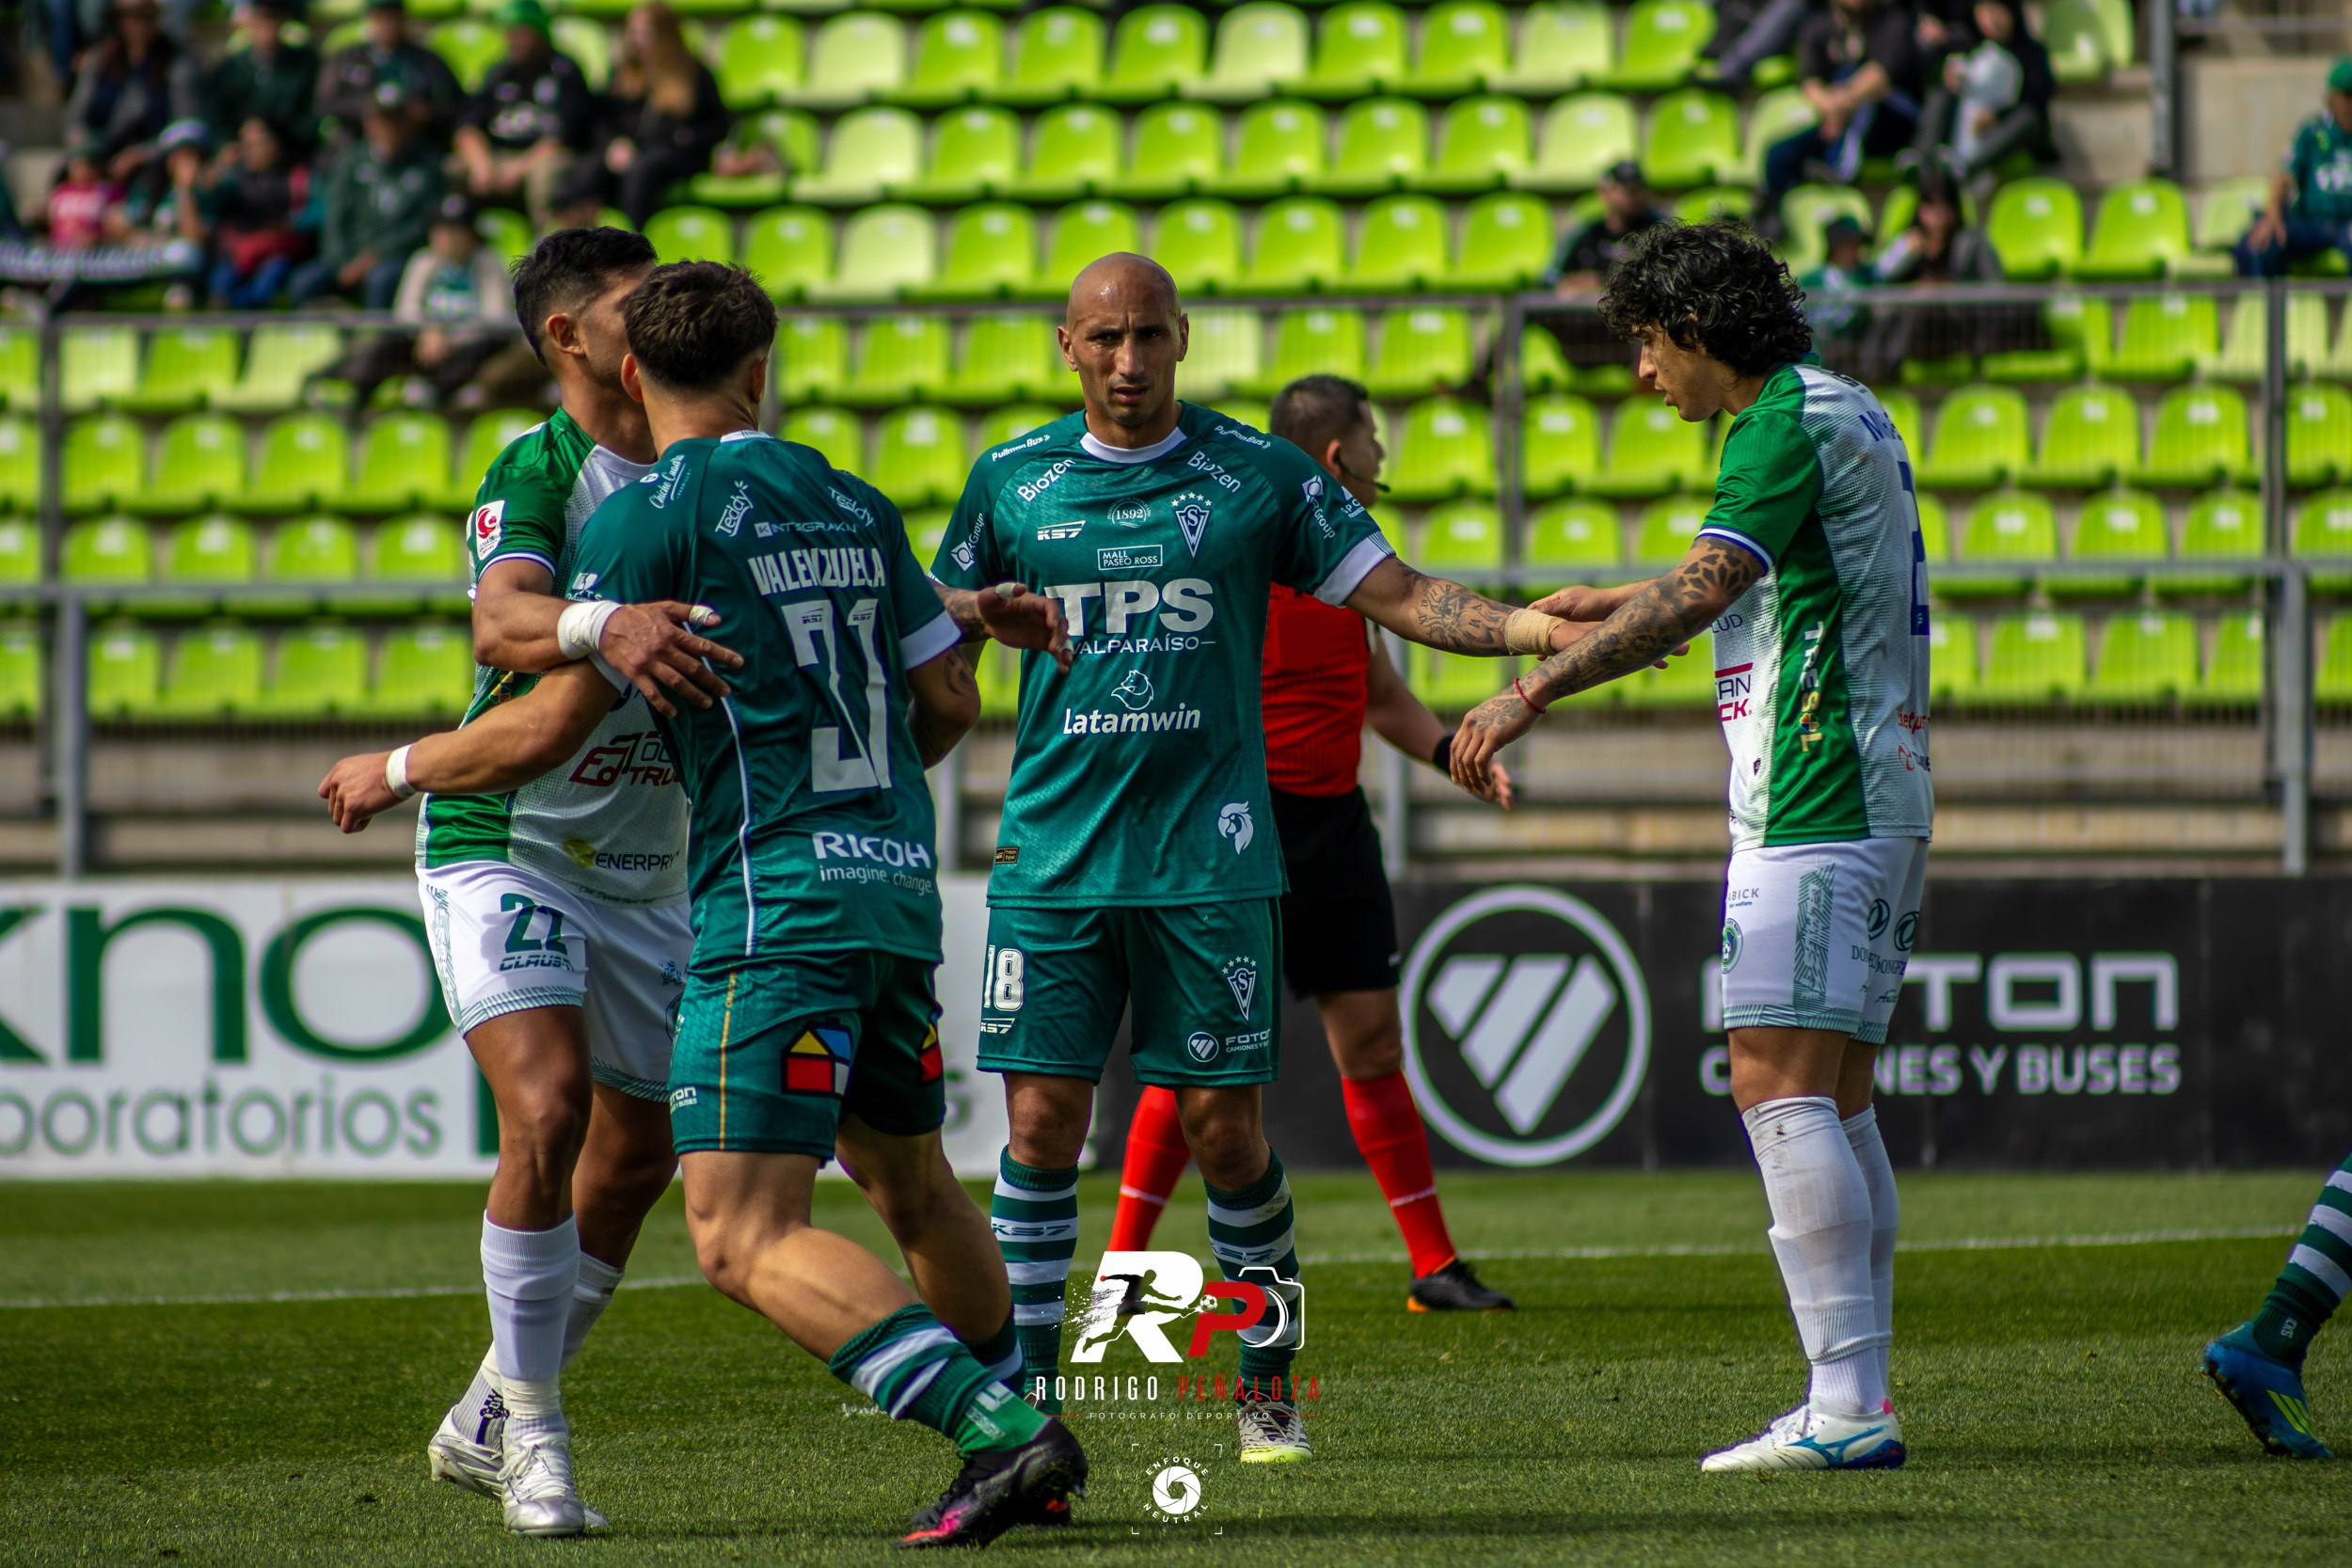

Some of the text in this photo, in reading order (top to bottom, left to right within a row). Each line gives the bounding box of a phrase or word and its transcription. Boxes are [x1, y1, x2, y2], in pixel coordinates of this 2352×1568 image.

[1017, 458, 1076, 502] Biozen
[1187, 450, 1242, 493] Biozen
[715, 487, 754, 537] Teddy
[1116, 509, 1144, 520] 1892
[748, 547, 886, 595] VALENZUELA
[1103, 550, 1129, 560] MALL
[1103, 556, 1158, 567] PASEO ROSS
[1043, 578, 1214, 637] TPS
[1063, 702, 1201, 736] Latamwin
[812, 832, 931, 869] RICOH
[819, 863, 934, 896] imagine. change.
[983, 945, 1025, 1012] 18
[1970, 1044, 2006, 1094] Y
[2016, 1044, 2181, 1095] BUSES
